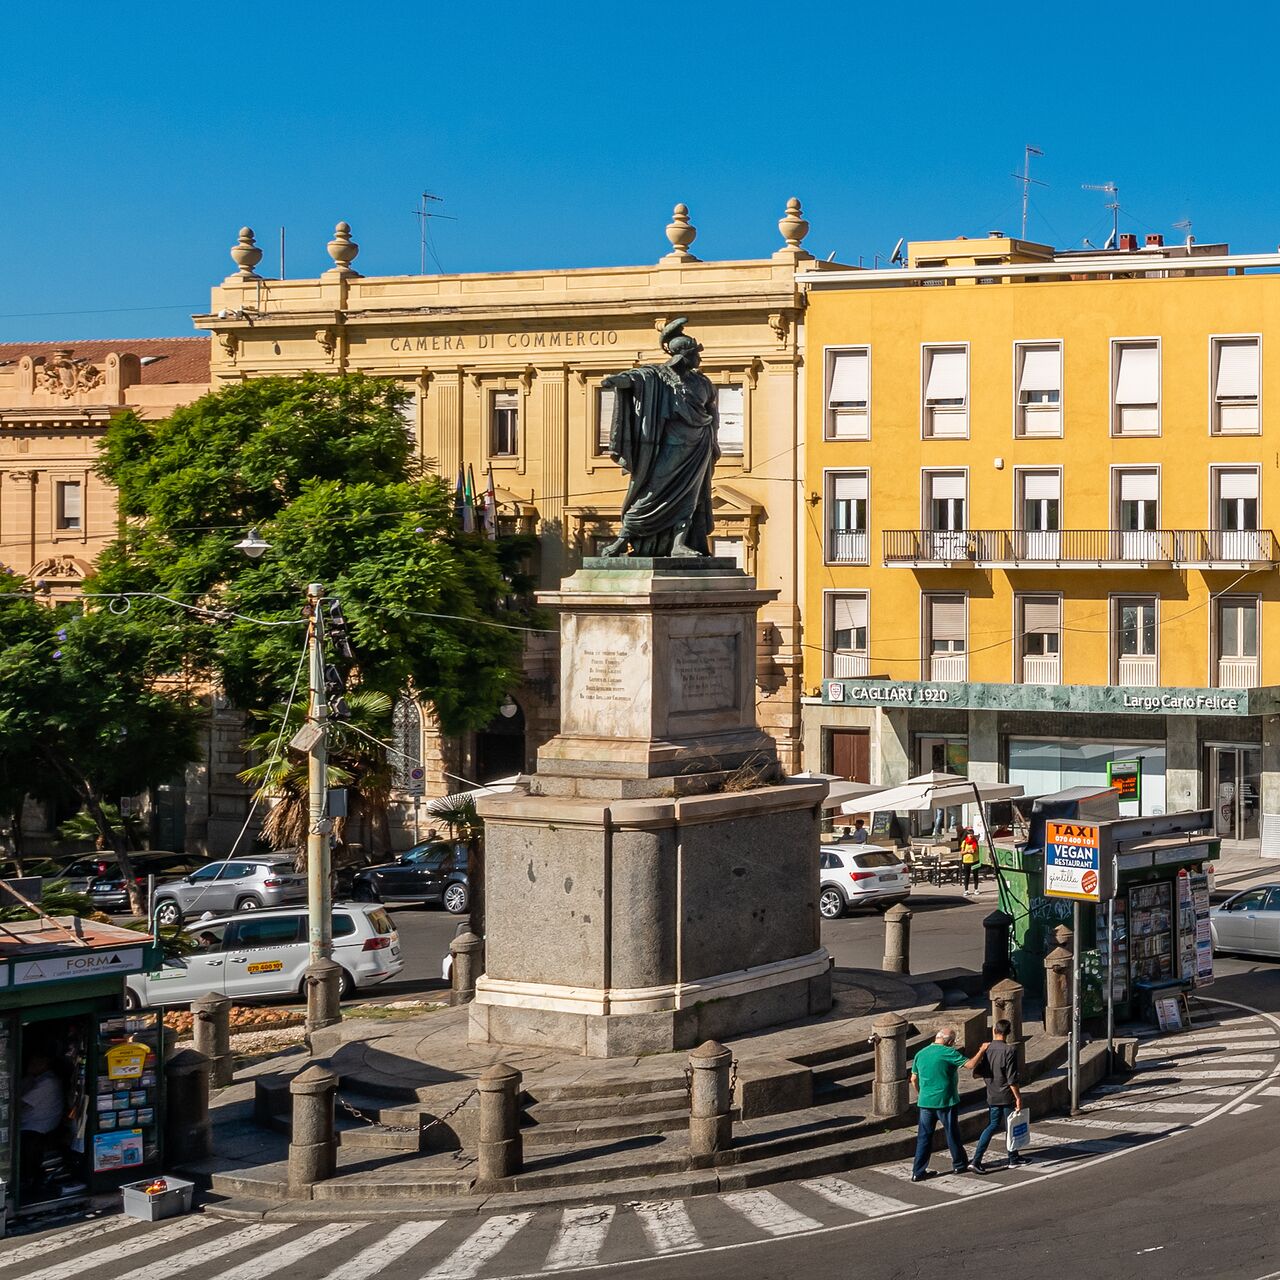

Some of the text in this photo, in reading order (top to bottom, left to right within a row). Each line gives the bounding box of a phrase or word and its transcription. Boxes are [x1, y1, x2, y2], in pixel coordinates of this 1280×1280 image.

[390, 331, 618, 352] CAMERA DI COMMERCIO
[851, 686, 948, 701] CAGLIARI 1920
[1123, 694, 1237, 710] Largo Carlo Felice
[1053, 824, 1094, 838] TAXI
[1055, 835, 1068, 843] 070
[1054, 844, 1093, 860] VEGAN
[1054, 858, 1093, 869] RESTAURANT
